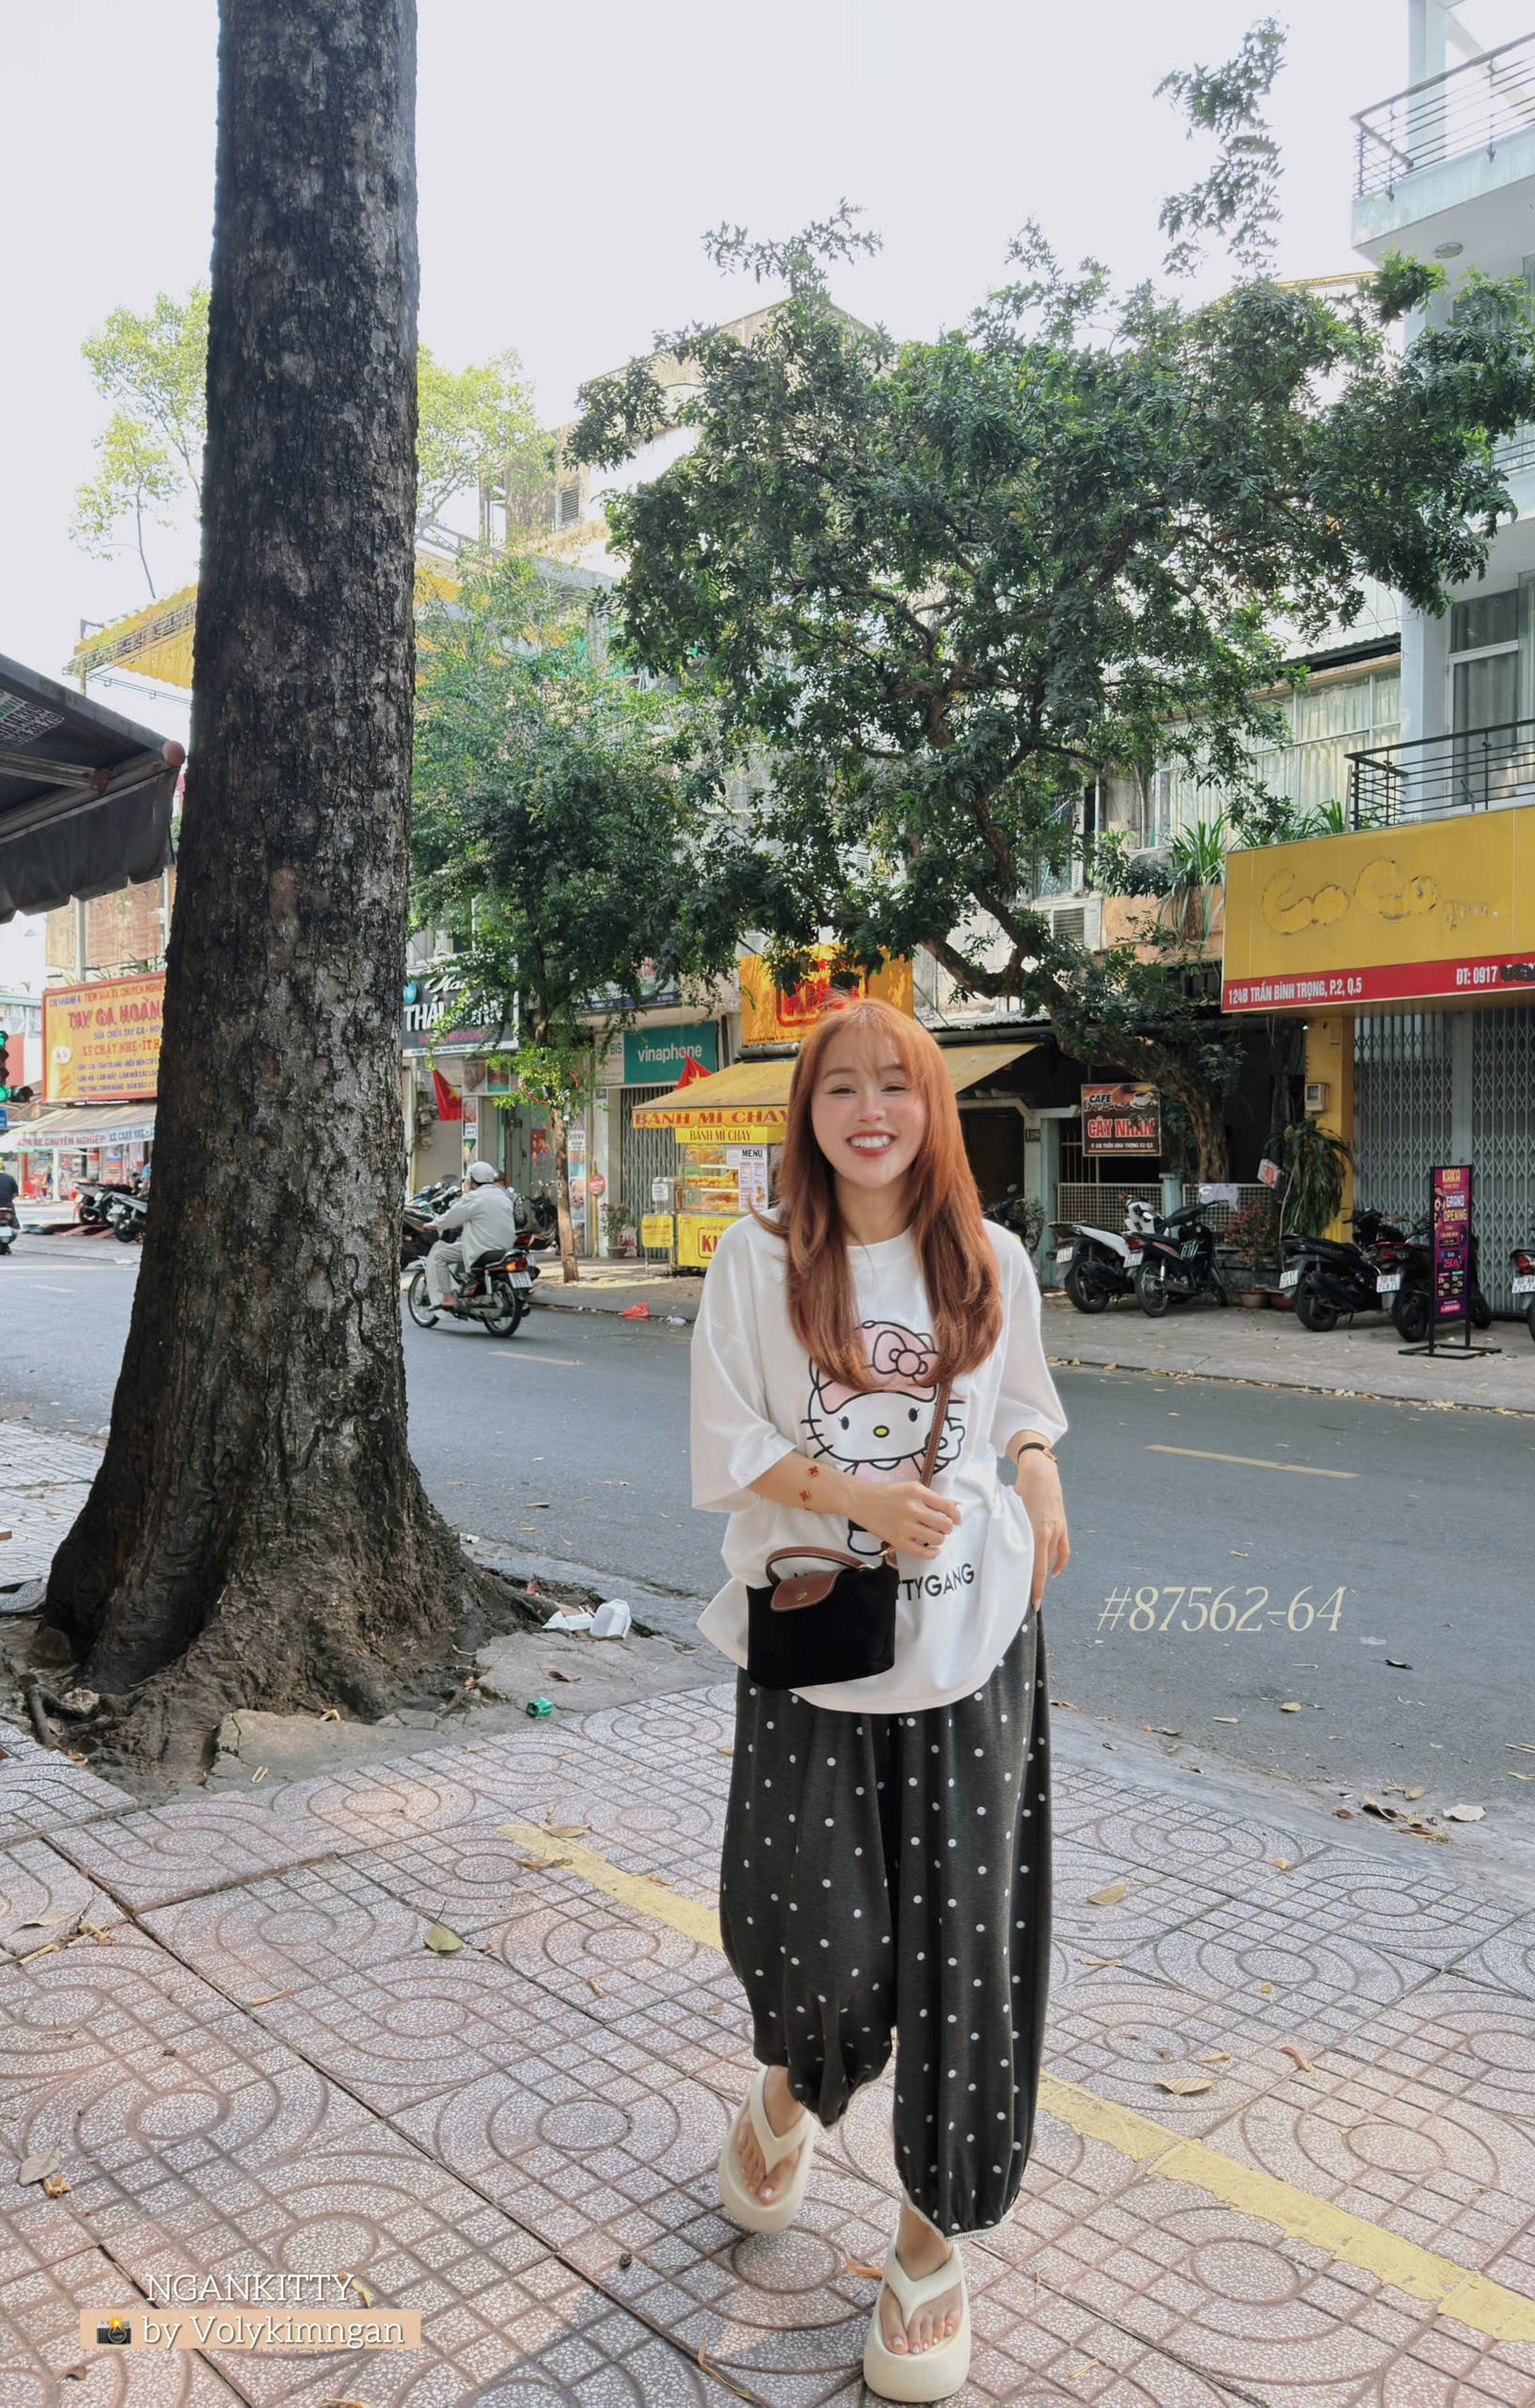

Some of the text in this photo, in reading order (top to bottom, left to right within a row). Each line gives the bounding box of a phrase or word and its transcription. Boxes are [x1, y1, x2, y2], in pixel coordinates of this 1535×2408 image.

[1229, 988, 1248, 1004] 124B
[1347, 978, 1362, 996] Q.5
[68, 996, 163, 1029] TAY GA HOÀN
[637, 1042, 702, 1064] vinaphone
[1088, 1115, 1113, 1139] CÂY
[742, 1149, 763, 1158] MENU
[1444, 1209, 1468, 1222] OPENING
